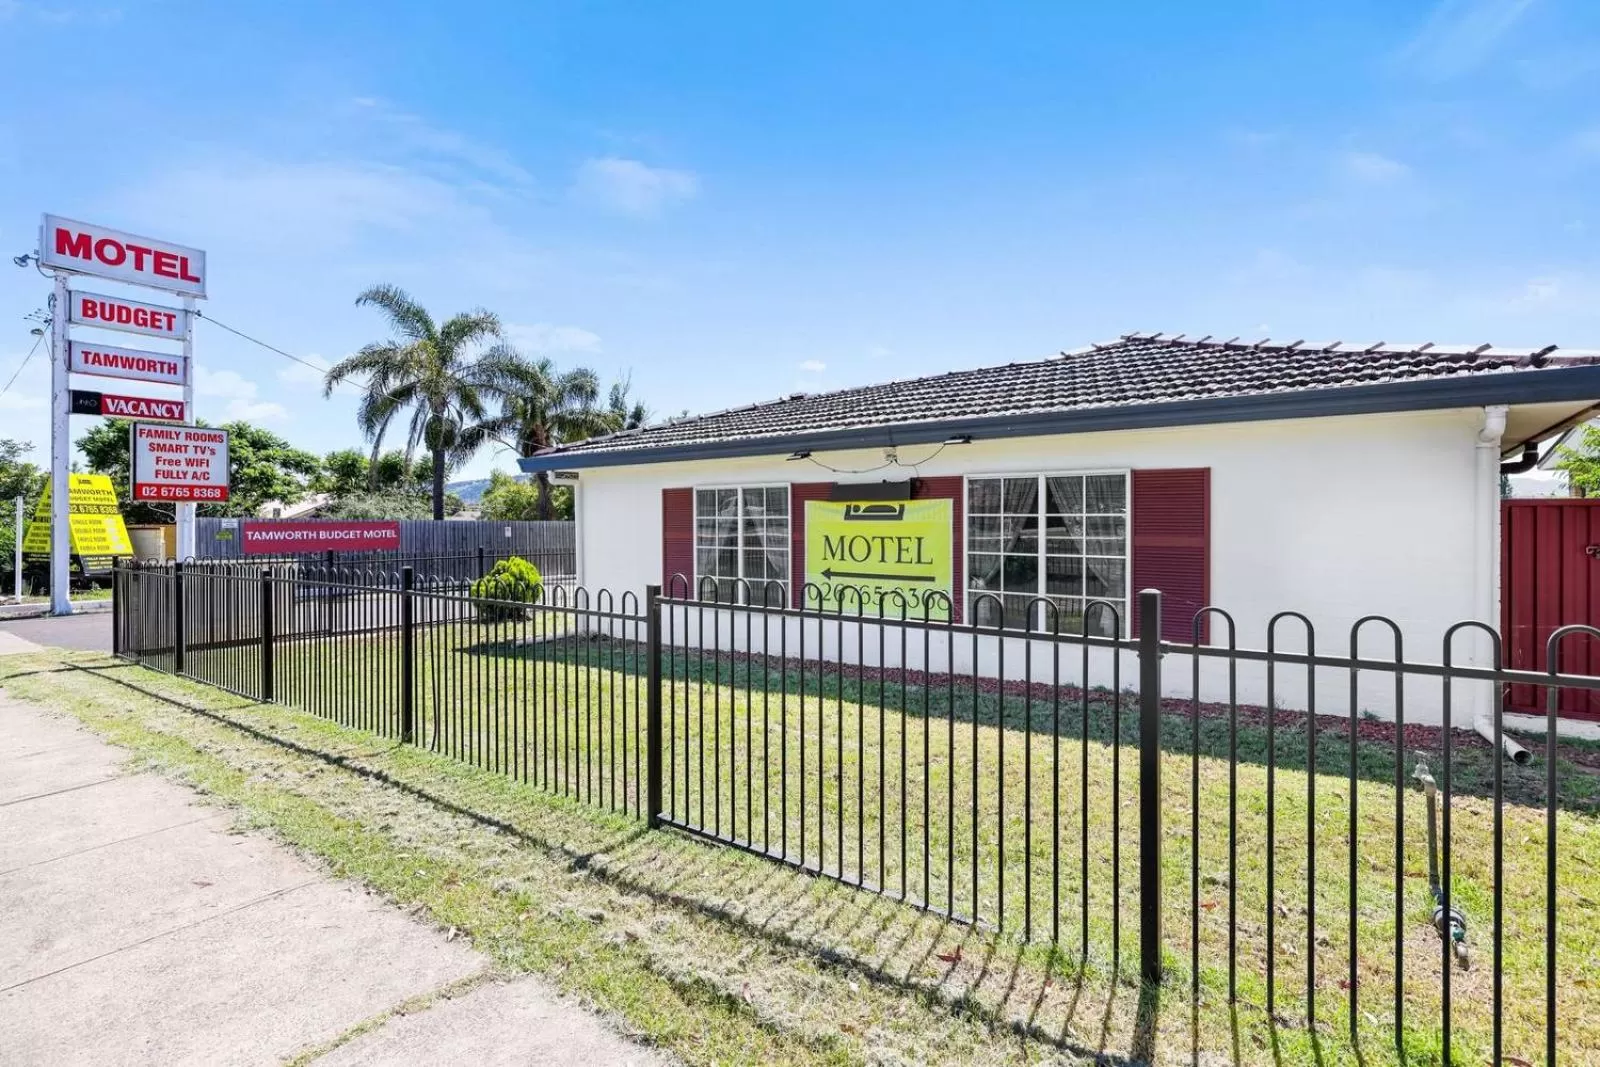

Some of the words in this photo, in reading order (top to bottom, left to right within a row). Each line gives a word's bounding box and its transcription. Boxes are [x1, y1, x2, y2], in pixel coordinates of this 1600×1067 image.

[56, 228, 200, 283] MOTEL
[82, 298, 176, 331] BUDGET
[81, 350, 178, 375] TAMWORTH
[106, 398, 182, 419] VACANCY
[139, 428, 181, 441] FAMILY
[185, 432, 224, 443] ROOMS
[148, 442, 189, 454] SMART
[193, 445, 216, 455] TV's
[156, 456, 181, 467] Free
[155, 469, 188, 480] FULLY
[191, 470, 210, 481] A/C
[68, 488, 113, 496] AMWORTH
[142, 486, 157, 496] 02
[161, 487, 189, 497] 6765
[193, 487, 221, 498] 8368
[246, 531, 316, 540] TAMWORTH
[319, 530, 362, 540] BUDGET
[363, 529, 398, 538] MOTEL
[822, 535, 933, 565] MOTEL
